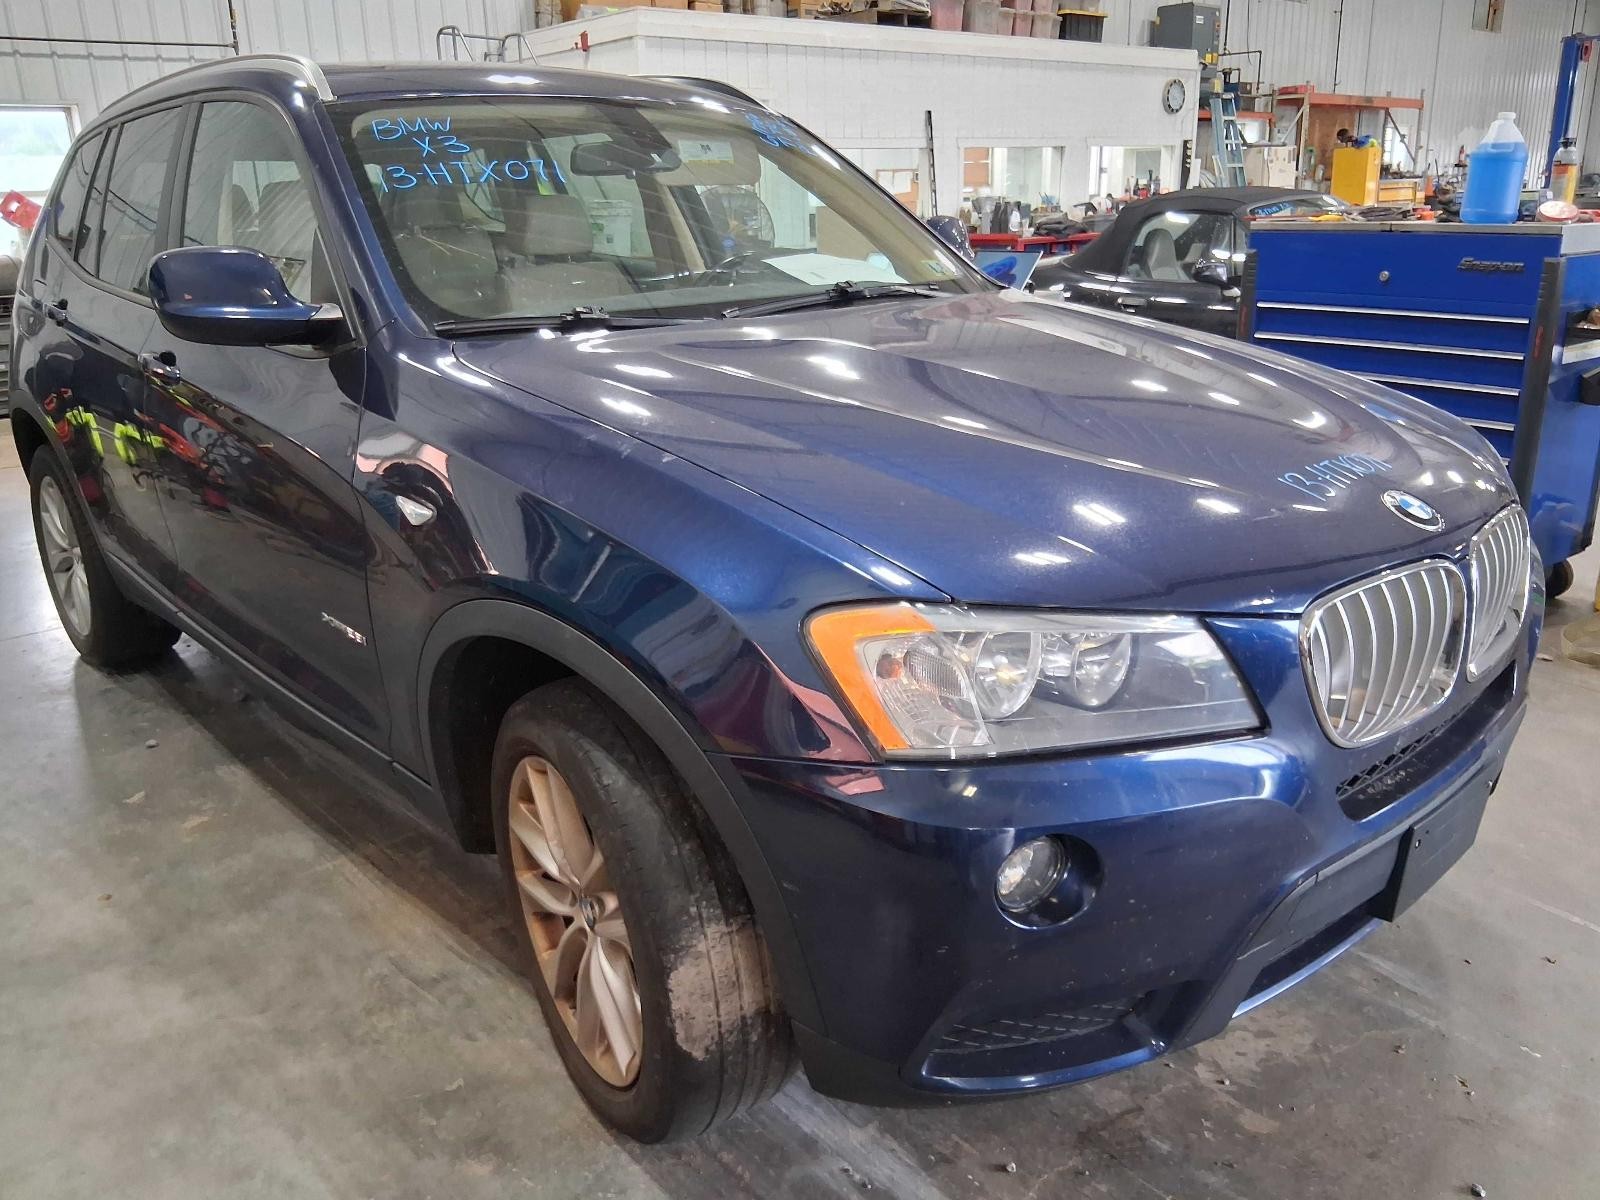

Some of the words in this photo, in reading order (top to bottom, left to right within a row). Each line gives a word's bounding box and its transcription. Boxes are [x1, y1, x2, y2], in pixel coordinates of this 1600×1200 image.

[371, 116, 452, 140] BMW
[412, 135, 471, 158] X3
[379, 159, 567, 193] 13-HTX071
